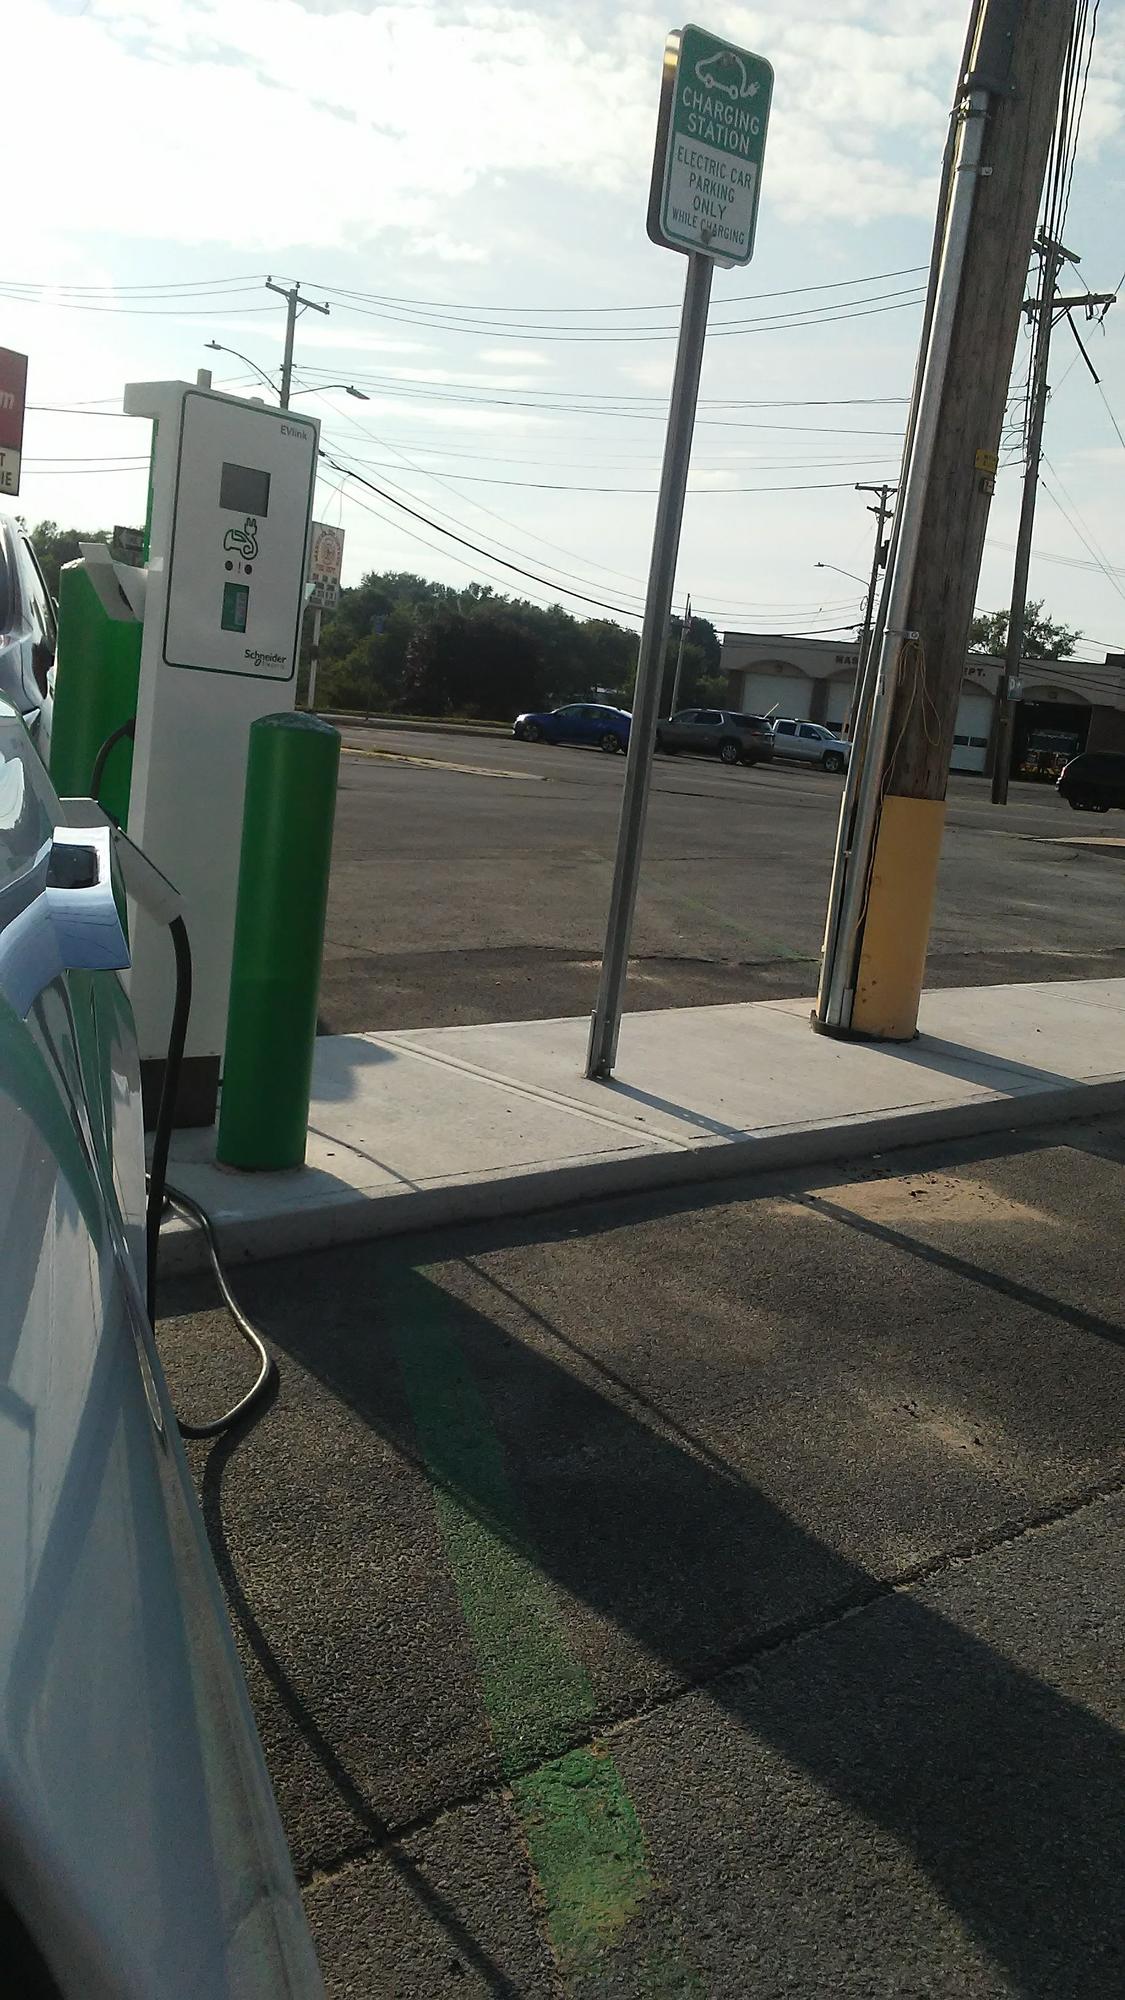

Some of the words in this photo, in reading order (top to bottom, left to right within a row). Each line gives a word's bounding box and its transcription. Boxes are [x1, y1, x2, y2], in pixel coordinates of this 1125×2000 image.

[682, 86, 760, 135] CHARGING
[687, 112, 750, 154] STATION
[677, 146, 726, 179] ELECTRIC
[731, 167, 752, 190] CAR
[689, 172, 735, 203] PARKING
[672, 207, 698, 228] WHILE
[700, 219, 745, 245] CHARGING
[693, 195, 727, 220] ONLY
[244, 649, 287, 663] Schneider
